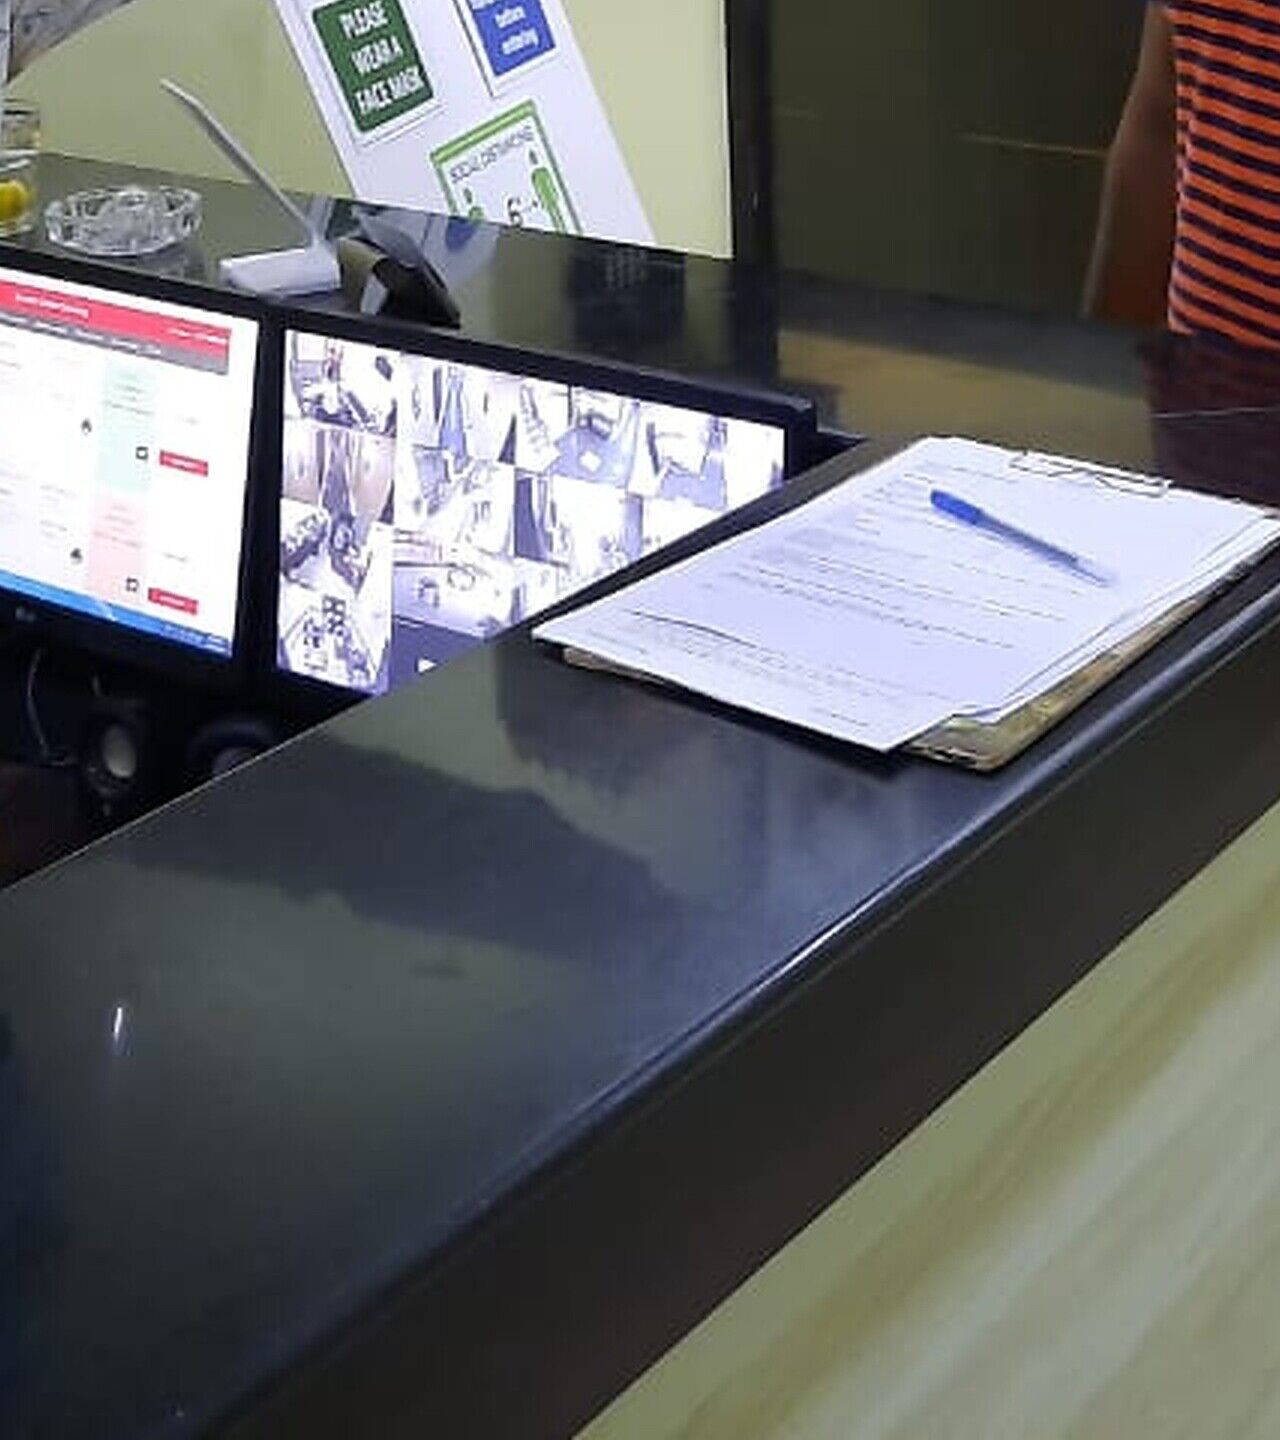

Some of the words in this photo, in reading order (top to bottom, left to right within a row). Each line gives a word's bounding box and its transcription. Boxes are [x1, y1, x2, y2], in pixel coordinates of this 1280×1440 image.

[340, 0, 388, 39] PLEASE
[351, 38, 393, 77] WEAR
[355, 80, 392, 115] FACE
[387, 65, 424, 100] MASK
